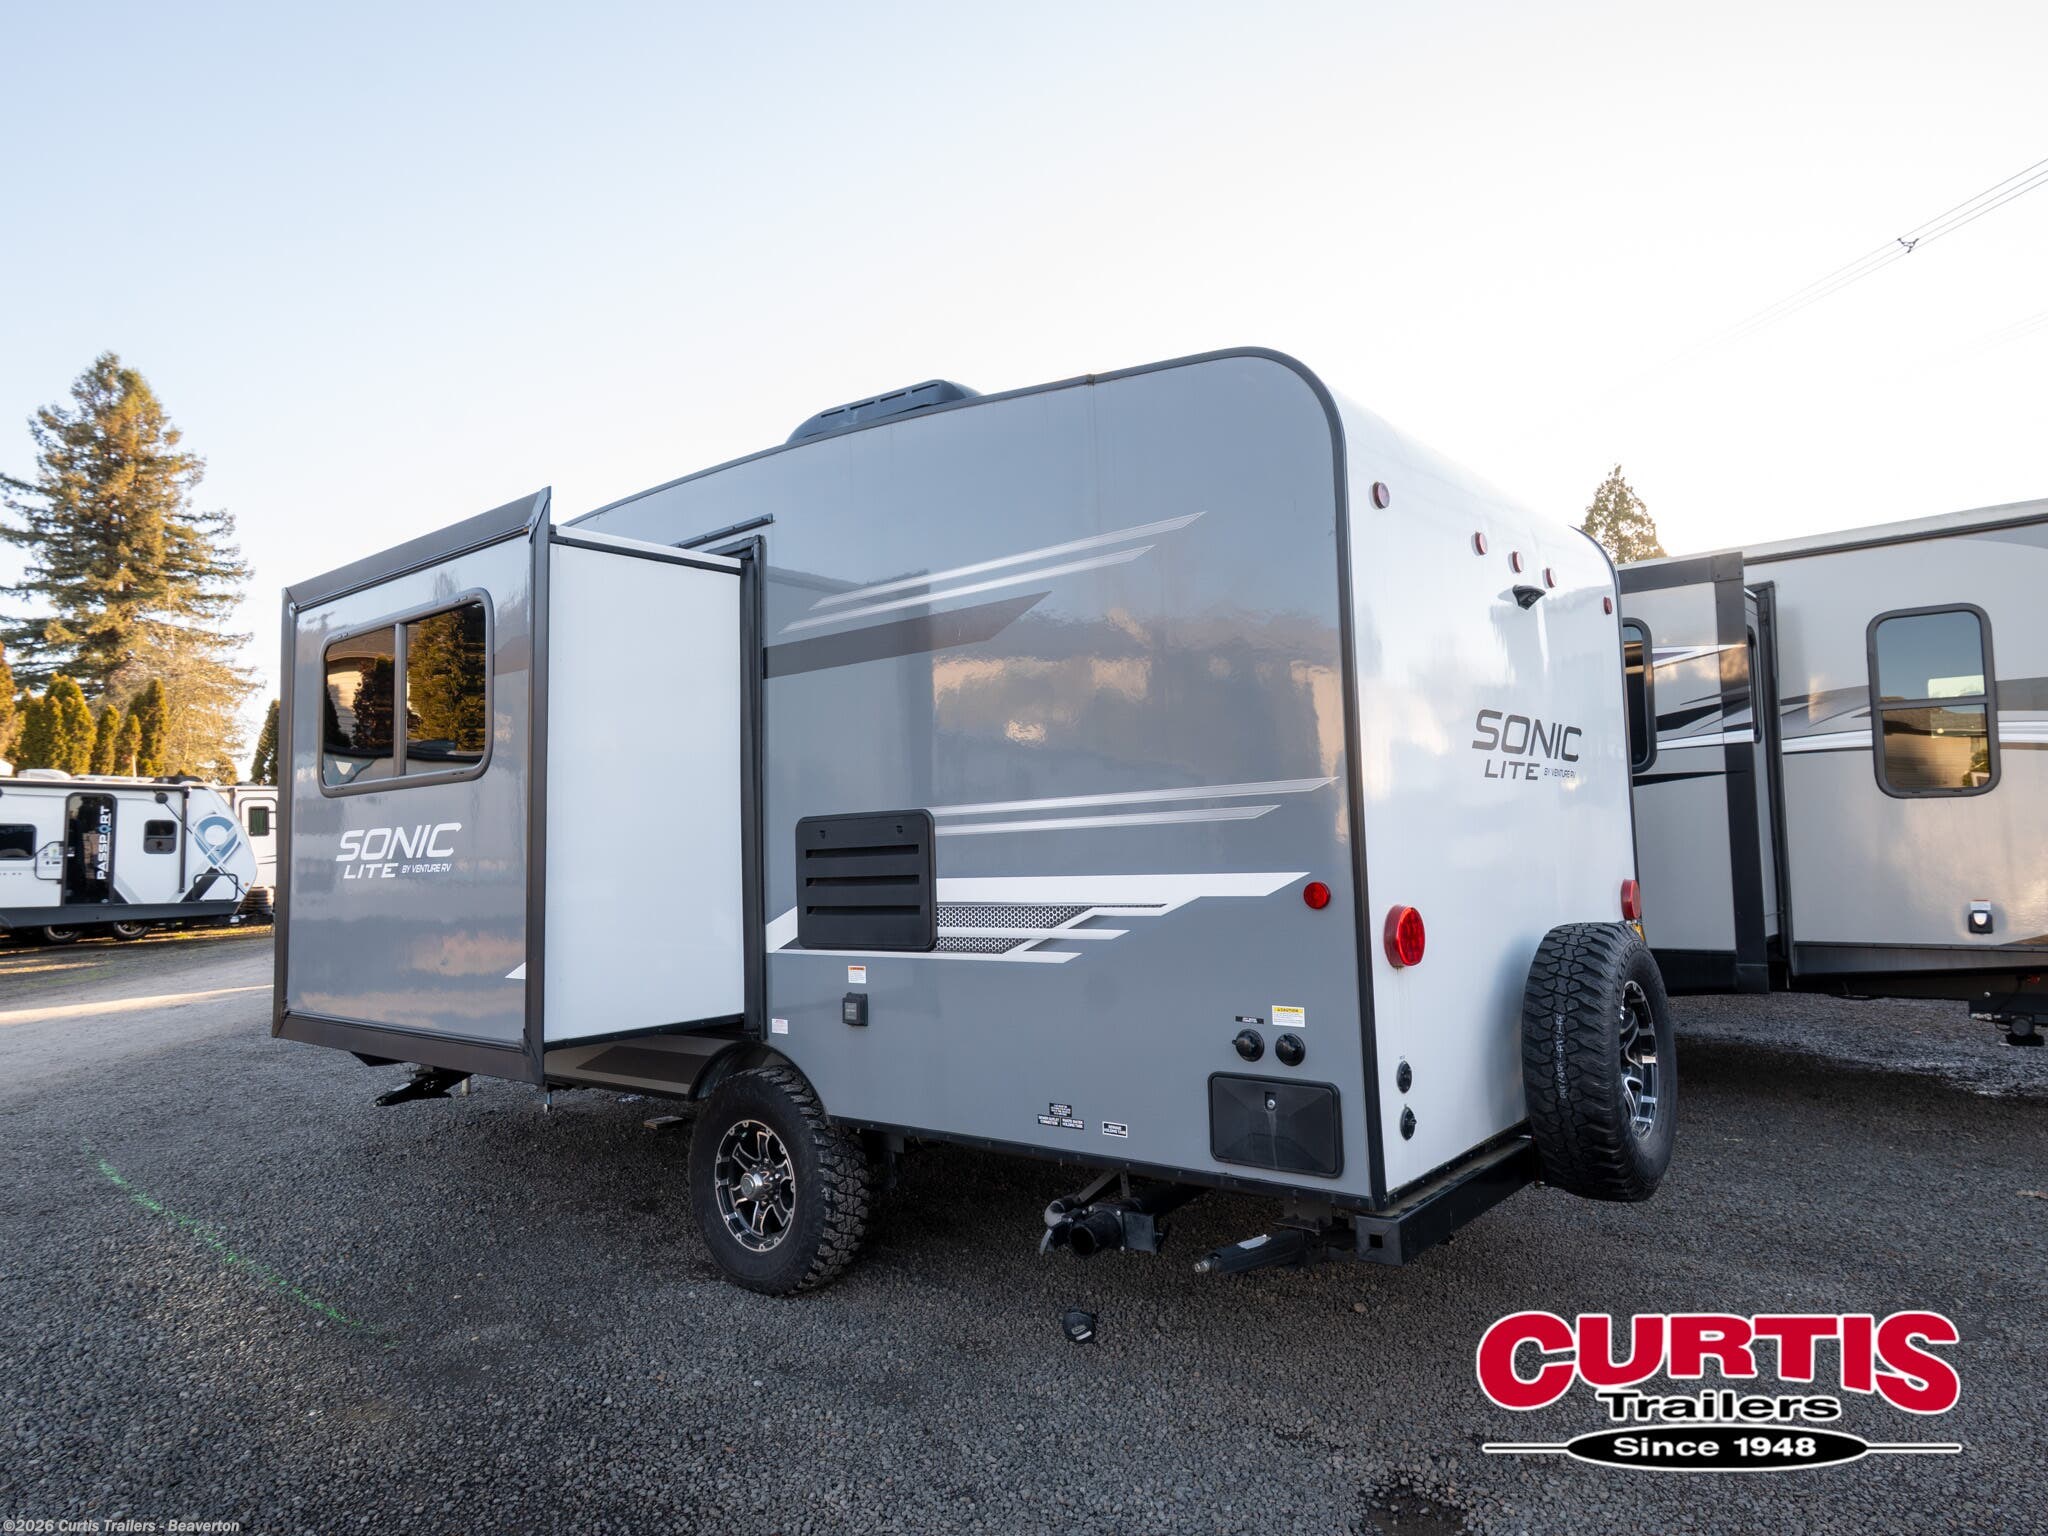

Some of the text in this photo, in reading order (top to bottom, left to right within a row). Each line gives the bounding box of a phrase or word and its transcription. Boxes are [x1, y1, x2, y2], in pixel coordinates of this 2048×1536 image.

[1471, 709, 1583, 763] SONIC
[1484, 759, 1541, 781] LITE
[96, 805, 112, 880] PASSPORT
[336, 822, 462, 861] SONIC
[343, 862, 452, 879] LITE BY VENTURE RV
